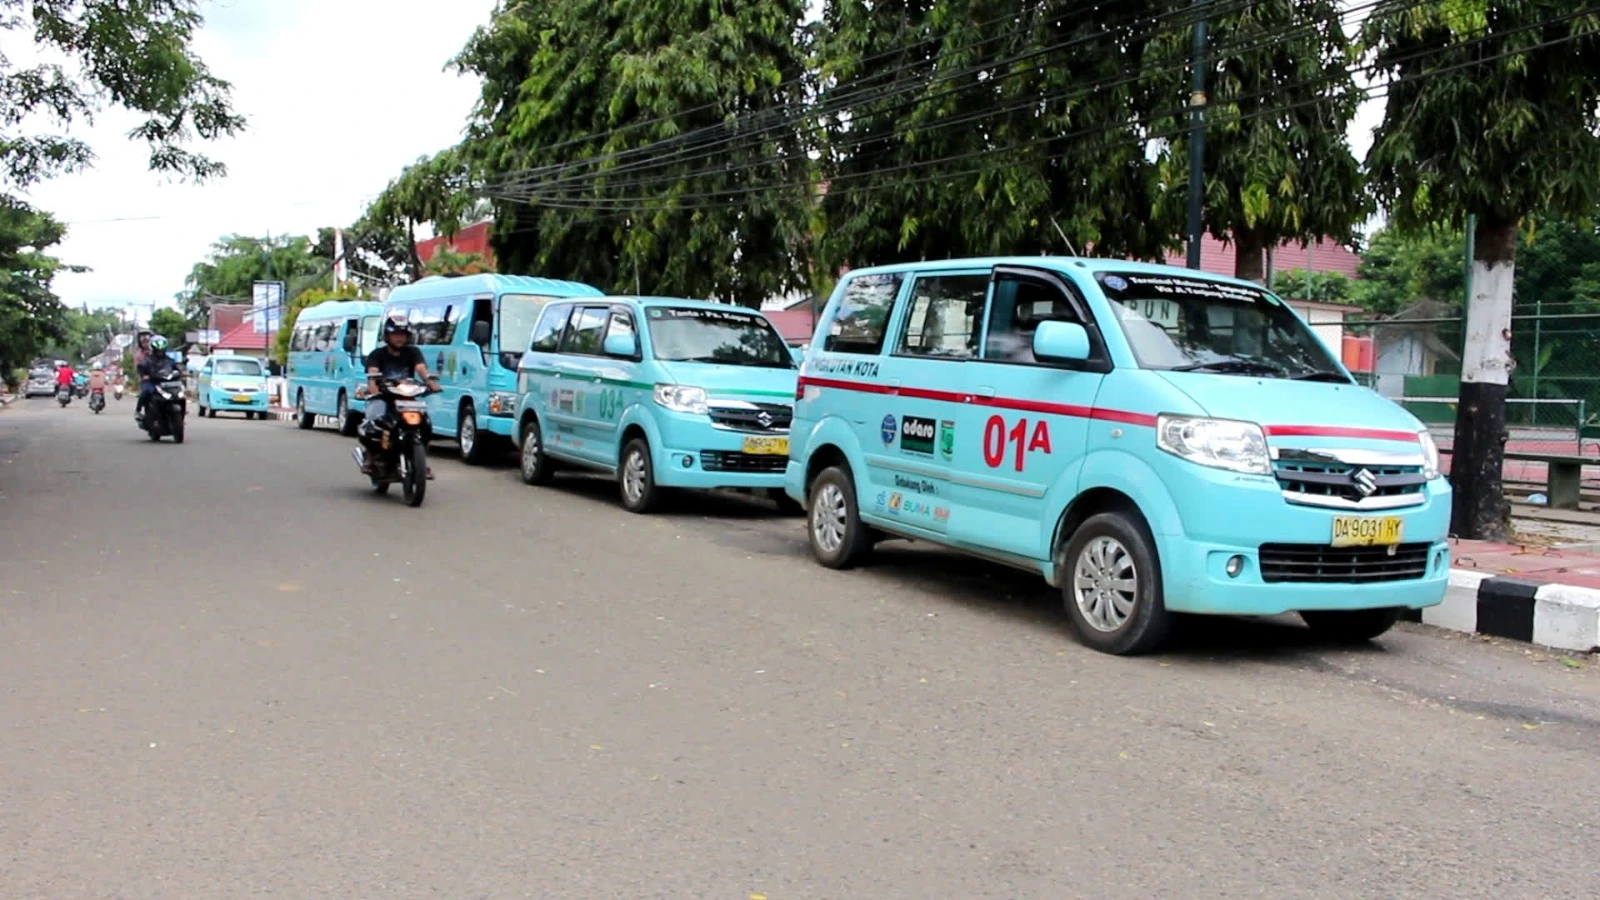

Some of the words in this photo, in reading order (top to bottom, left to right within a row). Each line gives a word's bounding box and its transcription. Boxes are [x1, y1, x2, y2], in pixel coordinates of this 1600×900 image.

[807, 359, 853, 374] NGKUTAN
[854, 361, 879, 378] KOTA
[903, 419, 934, 438] adaro
[984, 414, 1051, 472] 01A
[1335, 518, 1349, 538] DA
[1351, 519, 1382, 538] 9031
[1387, 519, 1402, 537] HY
